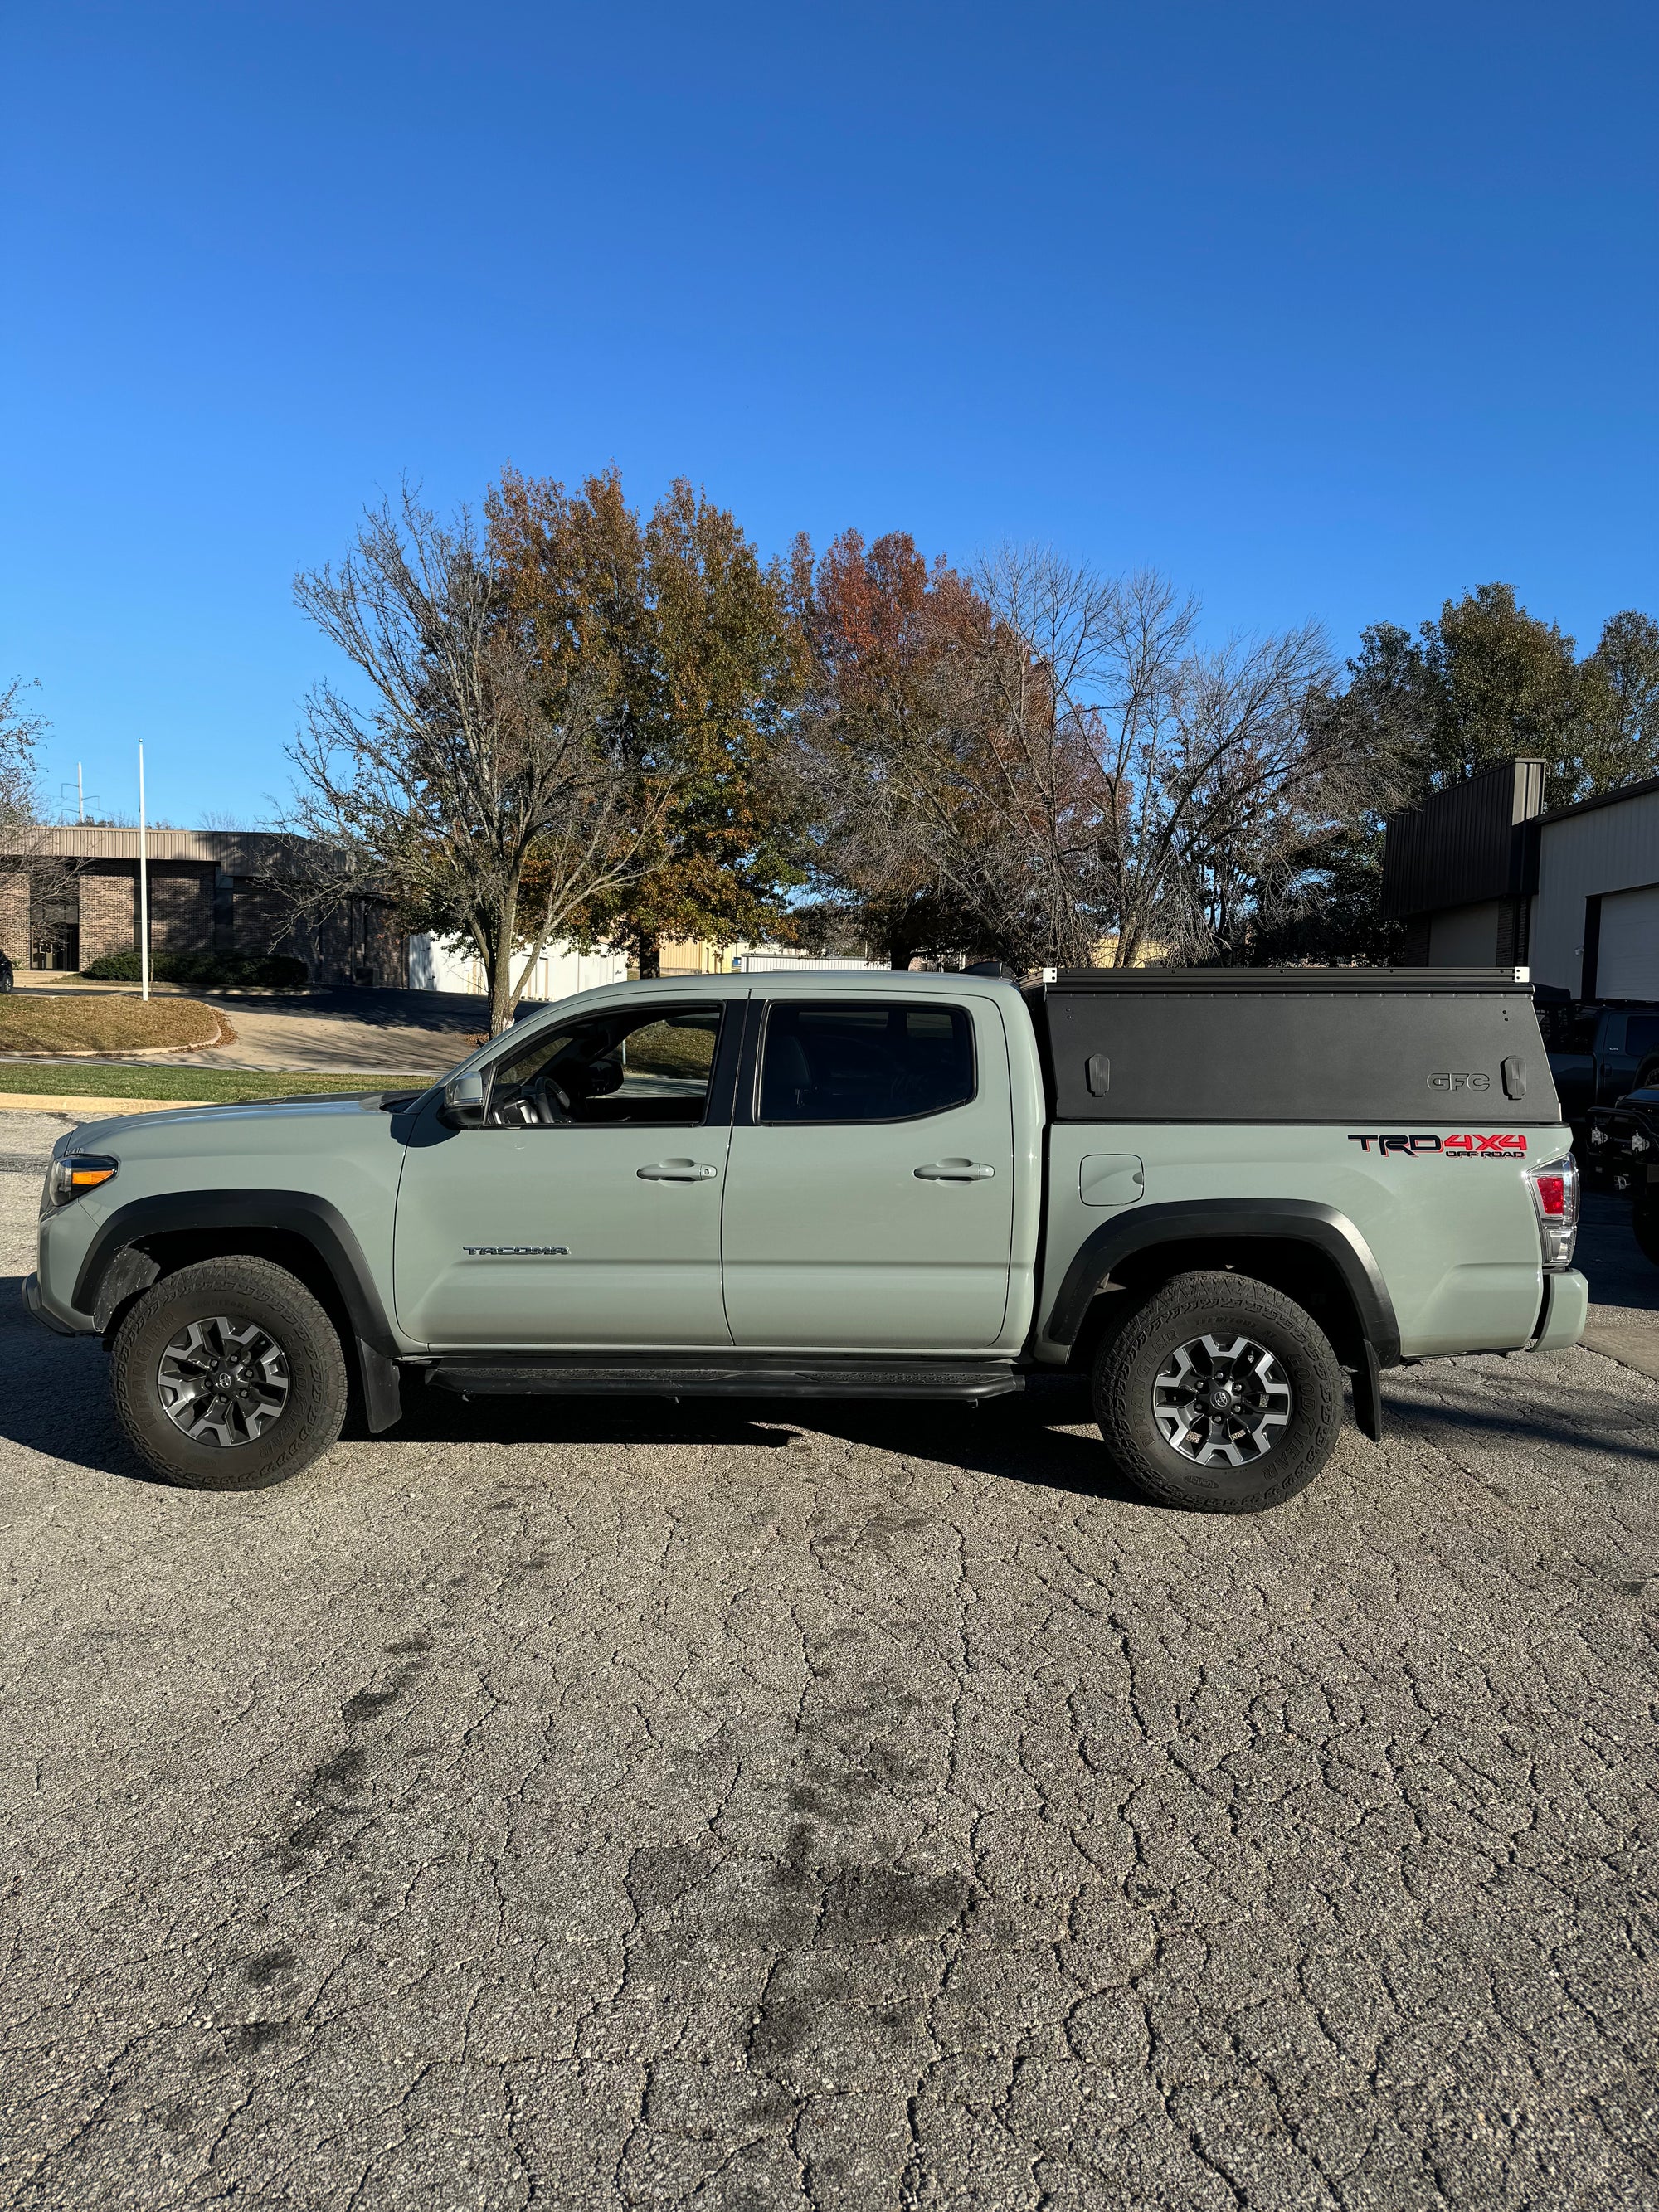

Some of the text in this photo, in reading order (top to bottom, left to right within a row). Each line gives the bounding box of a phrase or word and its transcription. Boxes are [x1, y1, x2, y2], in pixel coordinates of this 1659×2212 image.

[1427, 1072, 1490, 1091] GFC
[1347, 1134, 1443, 1158] TRD
[1445, 1150, 1526, 1159] OFF ROAD
[462, 1246, 572, 1256] TACOMA
[131, 1311, 178, 1430] WRANGLER
[1131, 1327, 1180, 1448] WRANGLER
